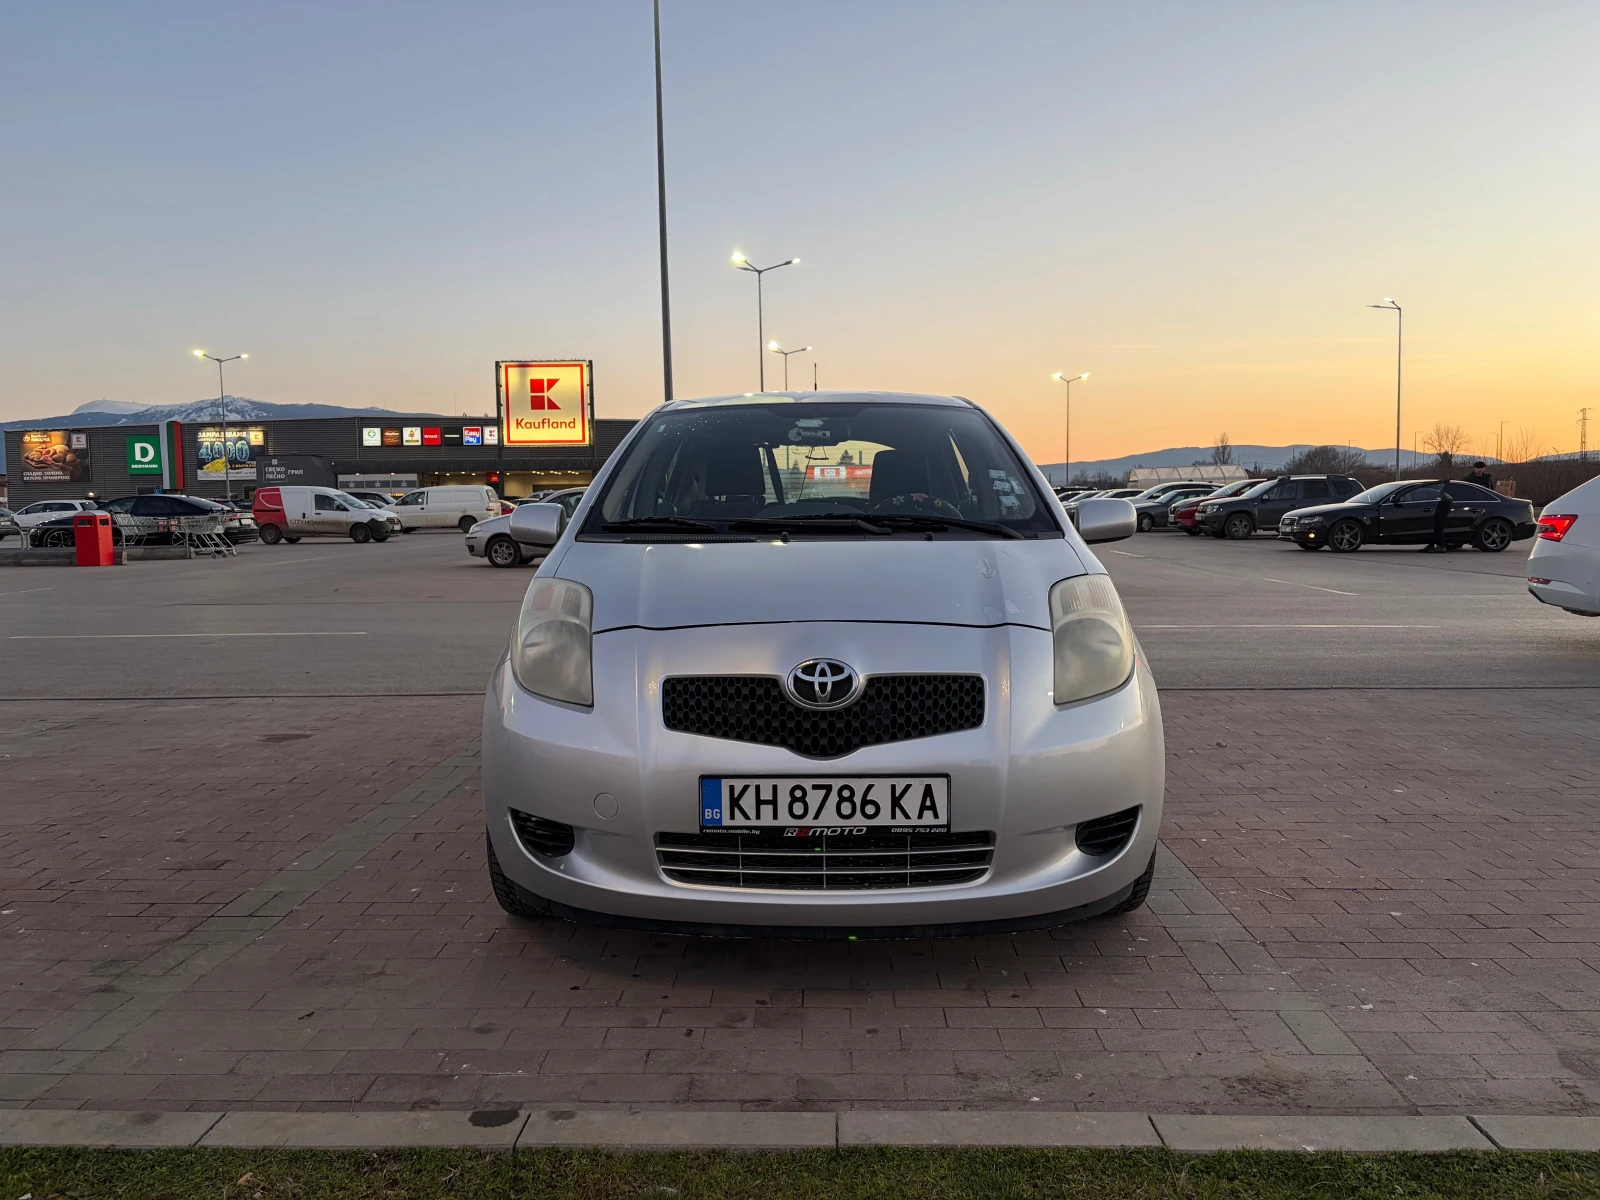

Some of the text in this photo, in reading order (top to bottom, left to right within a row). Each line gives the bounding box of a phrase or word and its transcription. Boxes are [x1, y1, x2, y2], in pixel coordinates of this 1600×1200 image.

[515, 417, 577, 430] Kaufland
[464, 429, 480, 437] Easy
[198, 440, 250, 462] 4000
[787, 783, 881, 821] 8786
[704, 808, 721, 820] BG
